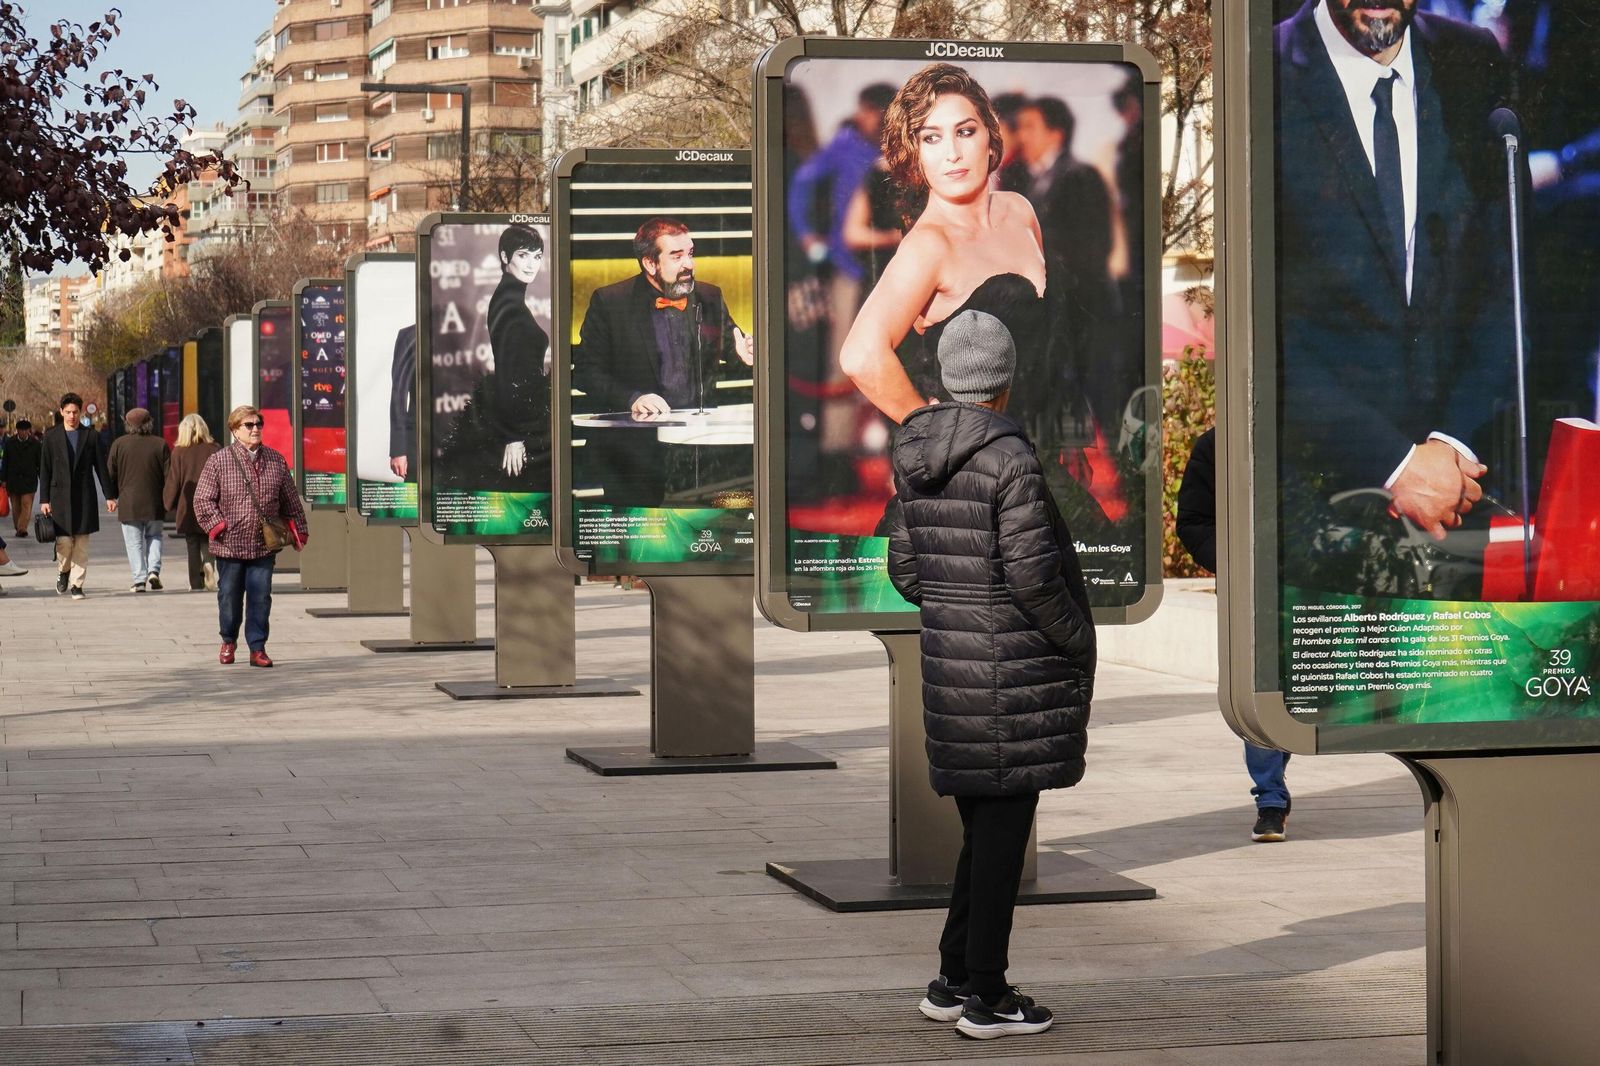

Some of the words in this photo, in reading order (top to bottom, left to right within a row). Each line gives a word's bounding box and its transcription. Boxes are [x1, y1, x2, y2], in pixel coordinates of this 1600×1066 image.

[926, 42, 1004, 58] JCDecaux
[676, 150, 734, 162] JCDecaux
[509, 214, 550, 223] JCDecau
[440, 302, 466, 334] A
[316, 348, 328, 360] A
[314, 383, 333, 392] rtve
[524, 519, 549, 527] GOYA
[701, 530, 712, 538] 39
[690, 542, 722, 552] GOYA
[1110, 544, 1131, 553] Goya
[1307, 615, 1342, 623] sevillanos
[1344, 614, 1377, 622] Alberto
[1379, 612, 1425, 622] Rodríguez
[1433, 611, 1461, 620] Rafael
[1463, 611, 1491, 619] Cobos
[1333, 626, 1359, 634] premio
[1367, 626, 1388, 634] Mejor
[1413, 624, 1449, 632] Adaptado
[1410, 636, 1426, 644] gala
[1490, 634, 1510, 642] Goya.
[1359, 650, 1396, 658] Rodríguez
[1549, 649, 1571, 666] 39
[1422, 660, 1440, 668] Goya
[1300, 673, 1334, 682] guionista
[1396, 682, 1414, 690] Goya
[1526, 676, 1591, 697] GOYA
